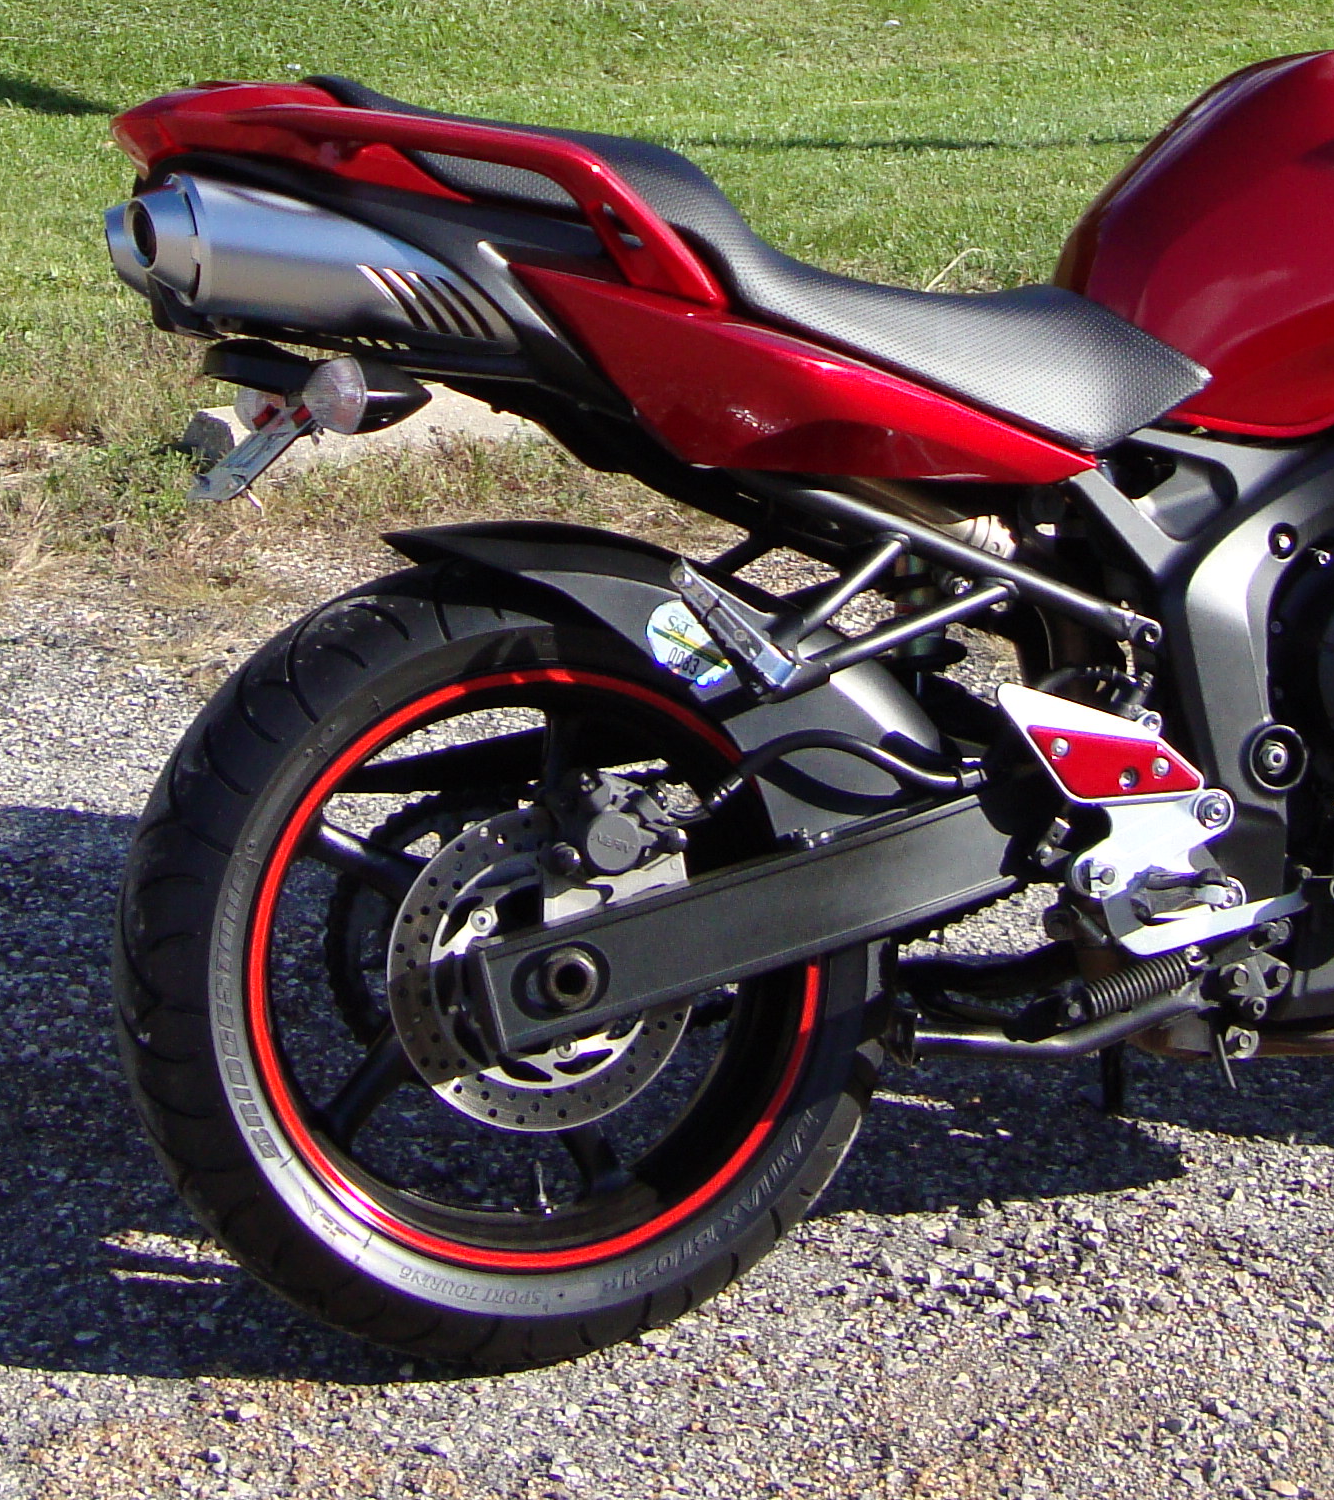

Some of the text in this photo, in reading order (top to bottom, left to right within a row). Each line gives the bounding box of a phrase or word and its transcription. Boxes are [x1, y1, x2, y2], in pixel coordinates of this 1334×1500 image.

[668, 646, 700, 675] 0083
[398, 1265, 542, 1305] SPORT TOURING
